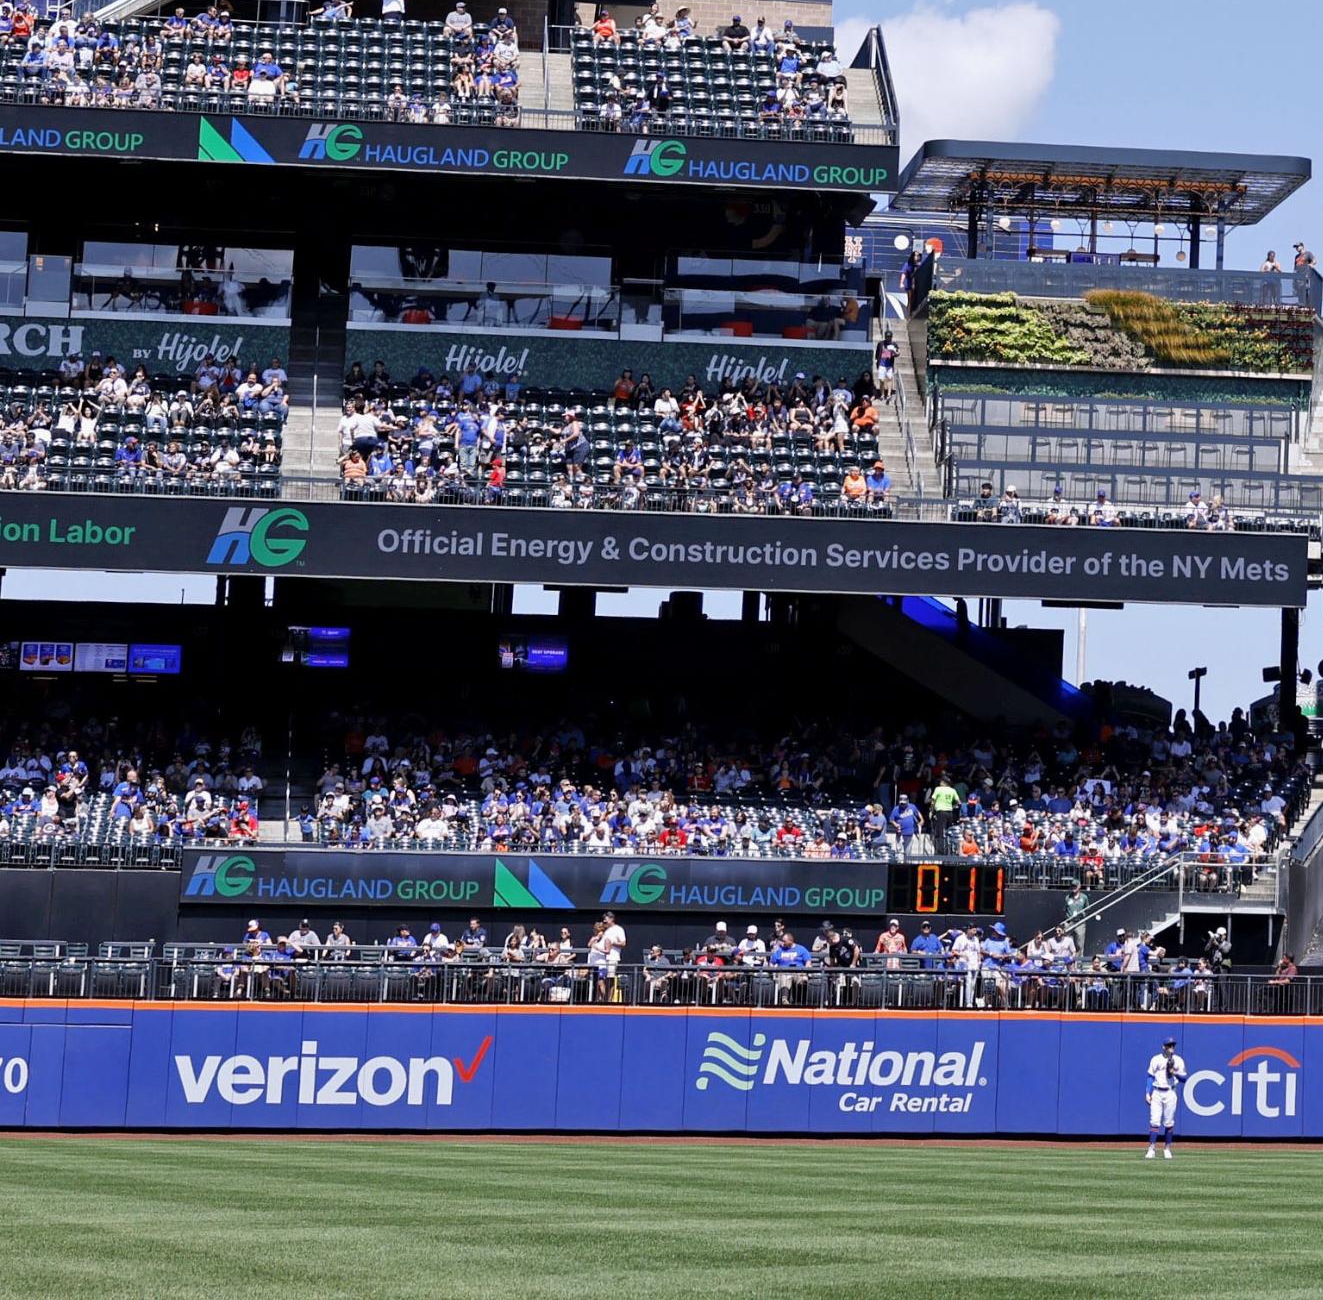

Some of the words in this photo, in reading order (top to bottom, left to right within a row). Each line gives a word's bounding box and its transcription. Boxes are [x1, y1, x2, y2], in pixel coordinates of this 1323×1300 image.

[65, 131, 144, 152] GROUP
[366, 144, 489, 169] HAUGLAND
[493, 149, 569, 171] GROUP
[689, 159, 809, 183] HAUGLAND
[813, 165, 888, 186] GROUP
[133, 348, 151, 359] BY
[49, 519, 135, 546] Labor
[377, 527, 484, 558] Official
[491, 532, 594, 564] Energy
[601, 536, 620, 561] &
[628, 538, 817, 569] Construction
[826, 544, 949, 572] Services
[957, 549, 1076, 578] Provider
[1084, 552, 1112, 579] of
[1119, 554, 1164, 580] the
[1172, 555, 1212, 580] NY
[1220, 556, 1289, 583] Mets
[258, 877, 392, 900] HAUGLAND
[397, 880, 479, 901] GROUP
[670, 884, 801, 907] HAUGLAND
[174, 1040, 454, 1106] verizon
[763, 1039, 985, 1086] National
[839, 1093, 882, 1112] Car
[890, 1093, 973, 1112] Rental
[1183, 1060, 1297, 1118] citi
